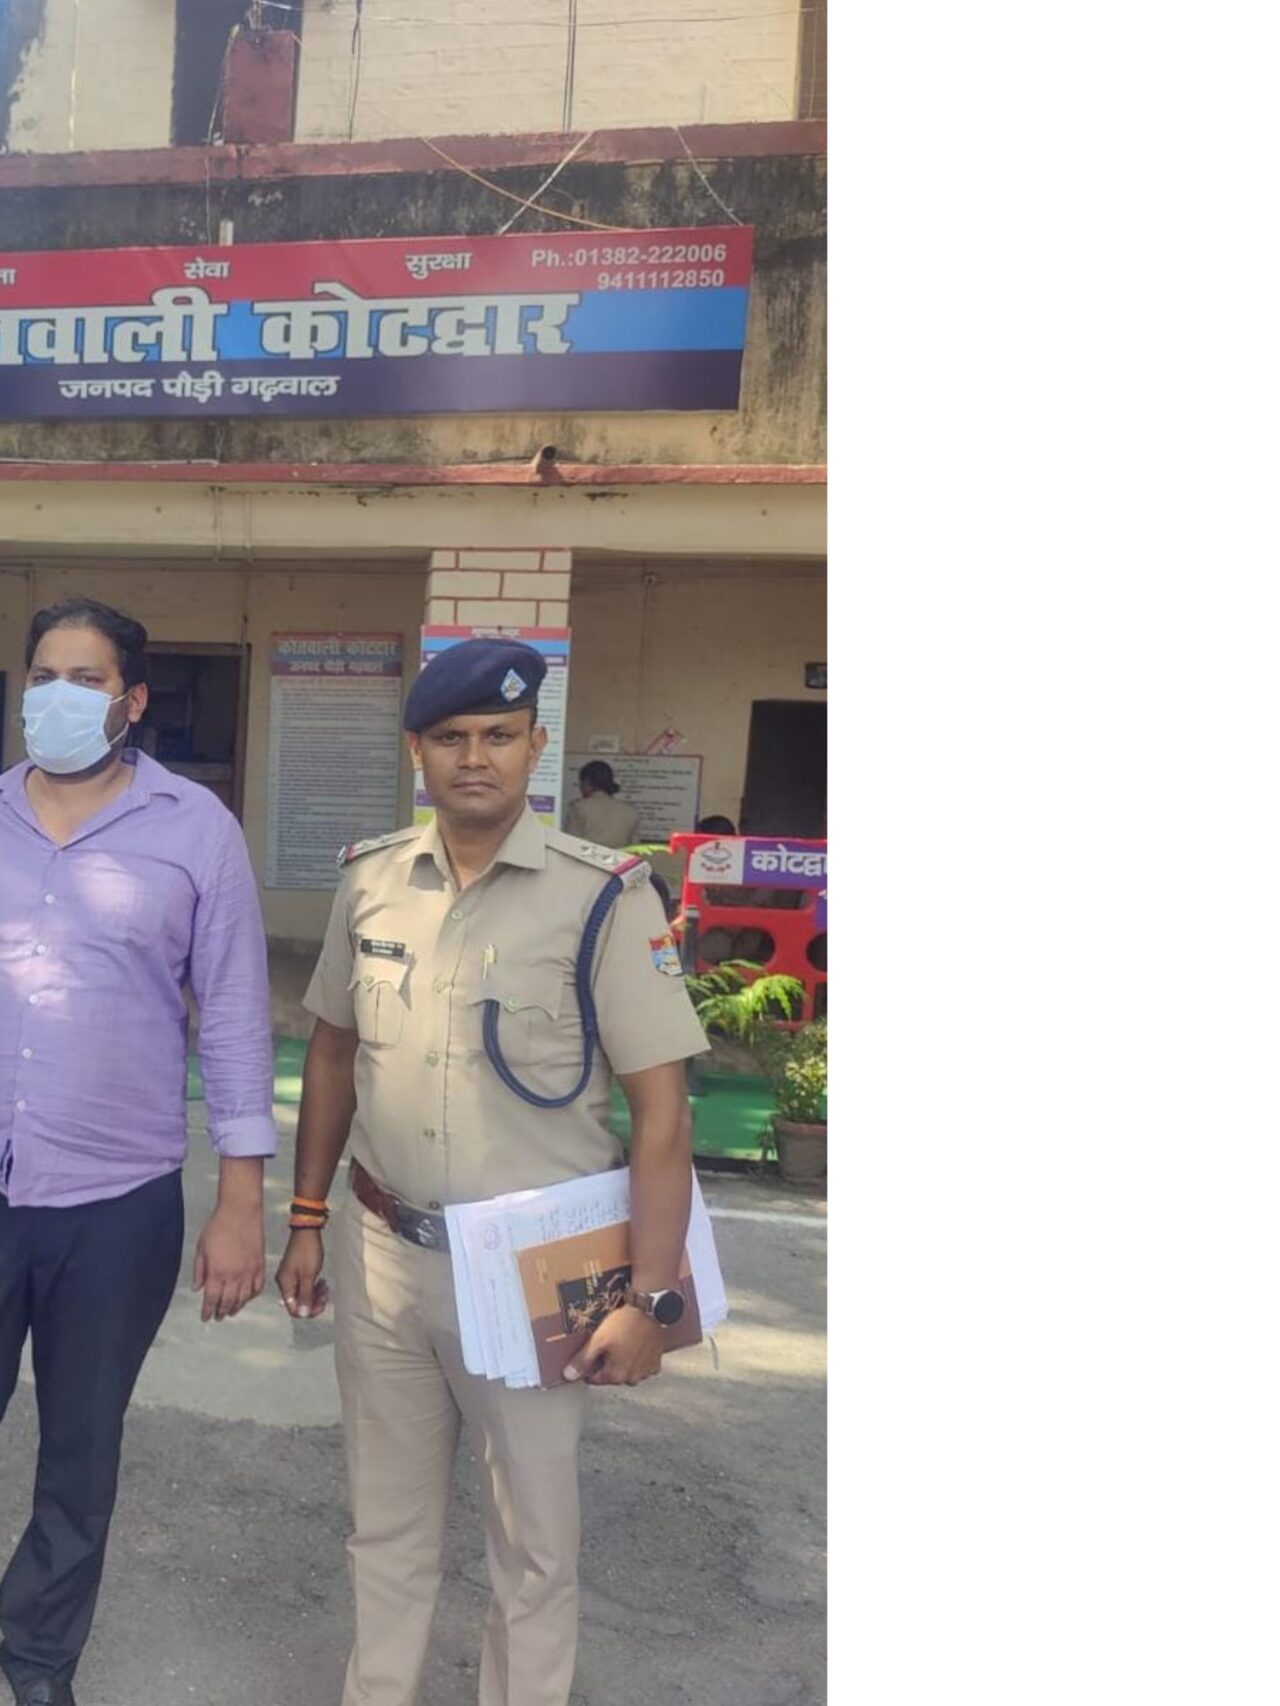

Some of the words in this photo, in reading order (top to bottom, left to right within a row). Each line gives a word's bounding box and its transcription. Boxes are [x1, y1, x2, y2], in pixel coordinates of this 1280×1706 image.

[184, 260, 230, 280] सेवा
[405, 252, 474, 278] सुरक्षा
[531, 244, 727, 268] Ph.:01382-222006
[597, 269, 725, 290] 9411112850
[252, 282, 580, 361] कोटद्वार
[59, 374, 154, 399] जनपद
[162, 371, 224, 404] पौड़ी
[231, 374, 339, 402] गढ़वाल
